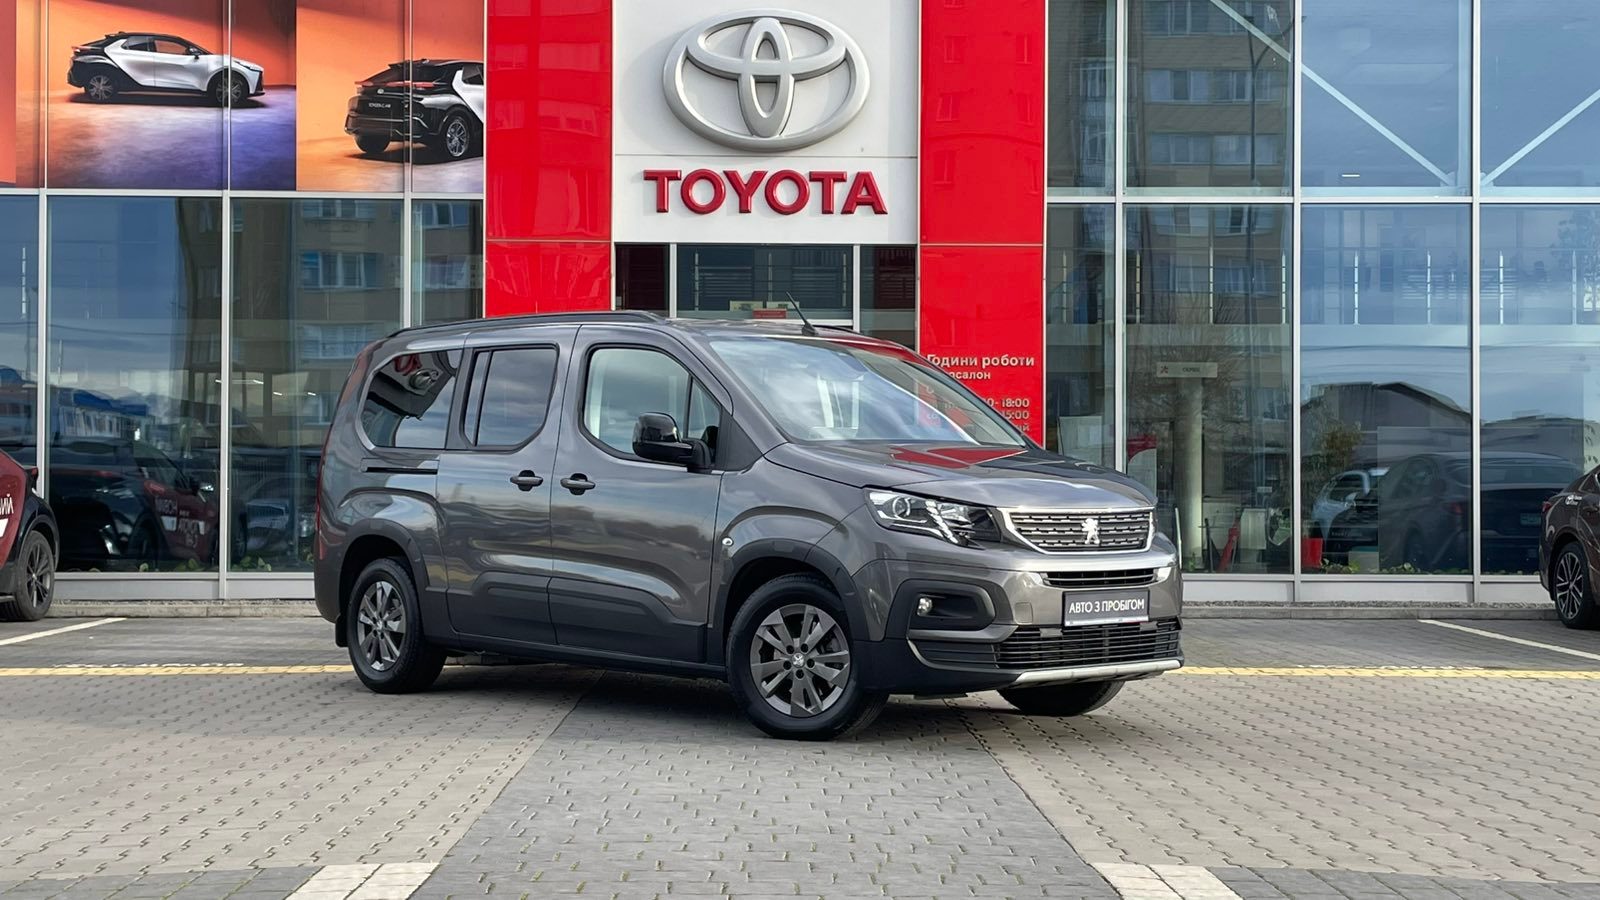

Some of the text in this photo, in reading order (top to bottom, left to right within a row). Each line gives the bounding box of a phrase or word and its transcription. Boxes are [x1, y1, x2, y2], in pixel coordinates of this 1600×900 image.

[643, 168, 888, 215] TOYOTA
[927, 353, 1035, 369] Години роботи
[949, 371, 991, 380] осалон
[1001, 397, 1030, 408] 18:00
[0, 493, 14, 516] ИЙ
[1069, 601, 1093, 614] АВТО
[1101, 598, 1145, 612] ПРОБІГОМ
